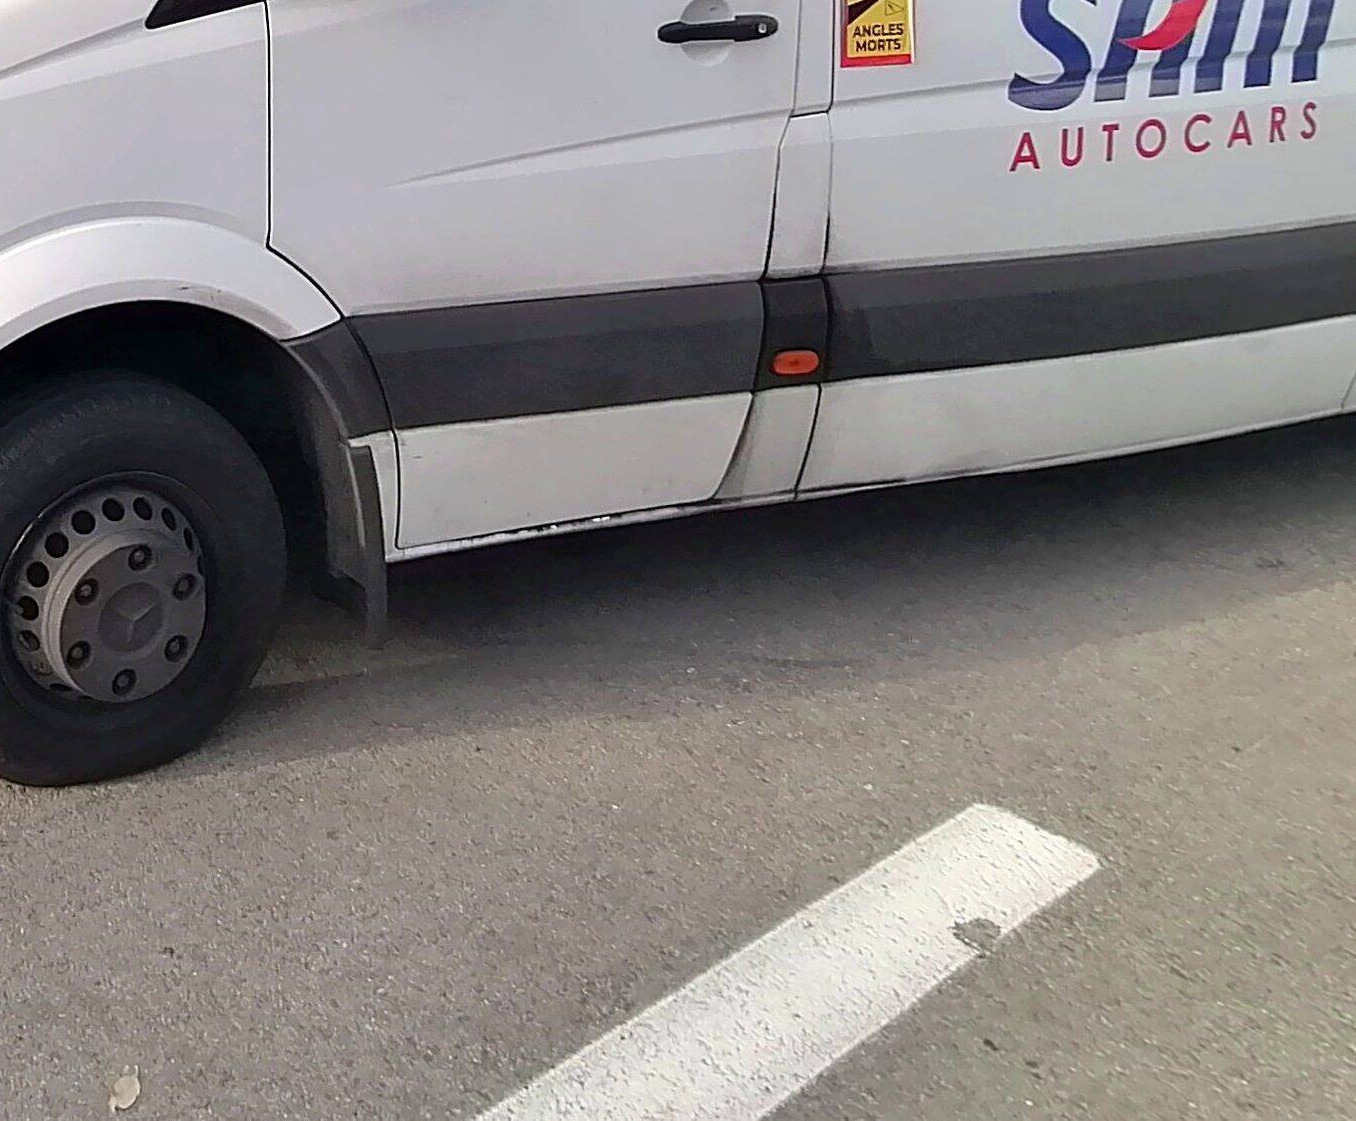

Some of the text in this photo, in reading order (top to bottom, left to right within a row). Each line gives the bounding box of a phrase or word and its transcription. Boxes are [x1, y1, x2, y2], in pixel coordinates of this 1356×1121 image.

[853, 23, 904, 38] ANGLES
[856, 39, 901, 52] MORTS
[1009, 101, 1318, 172] AUTOCARS
